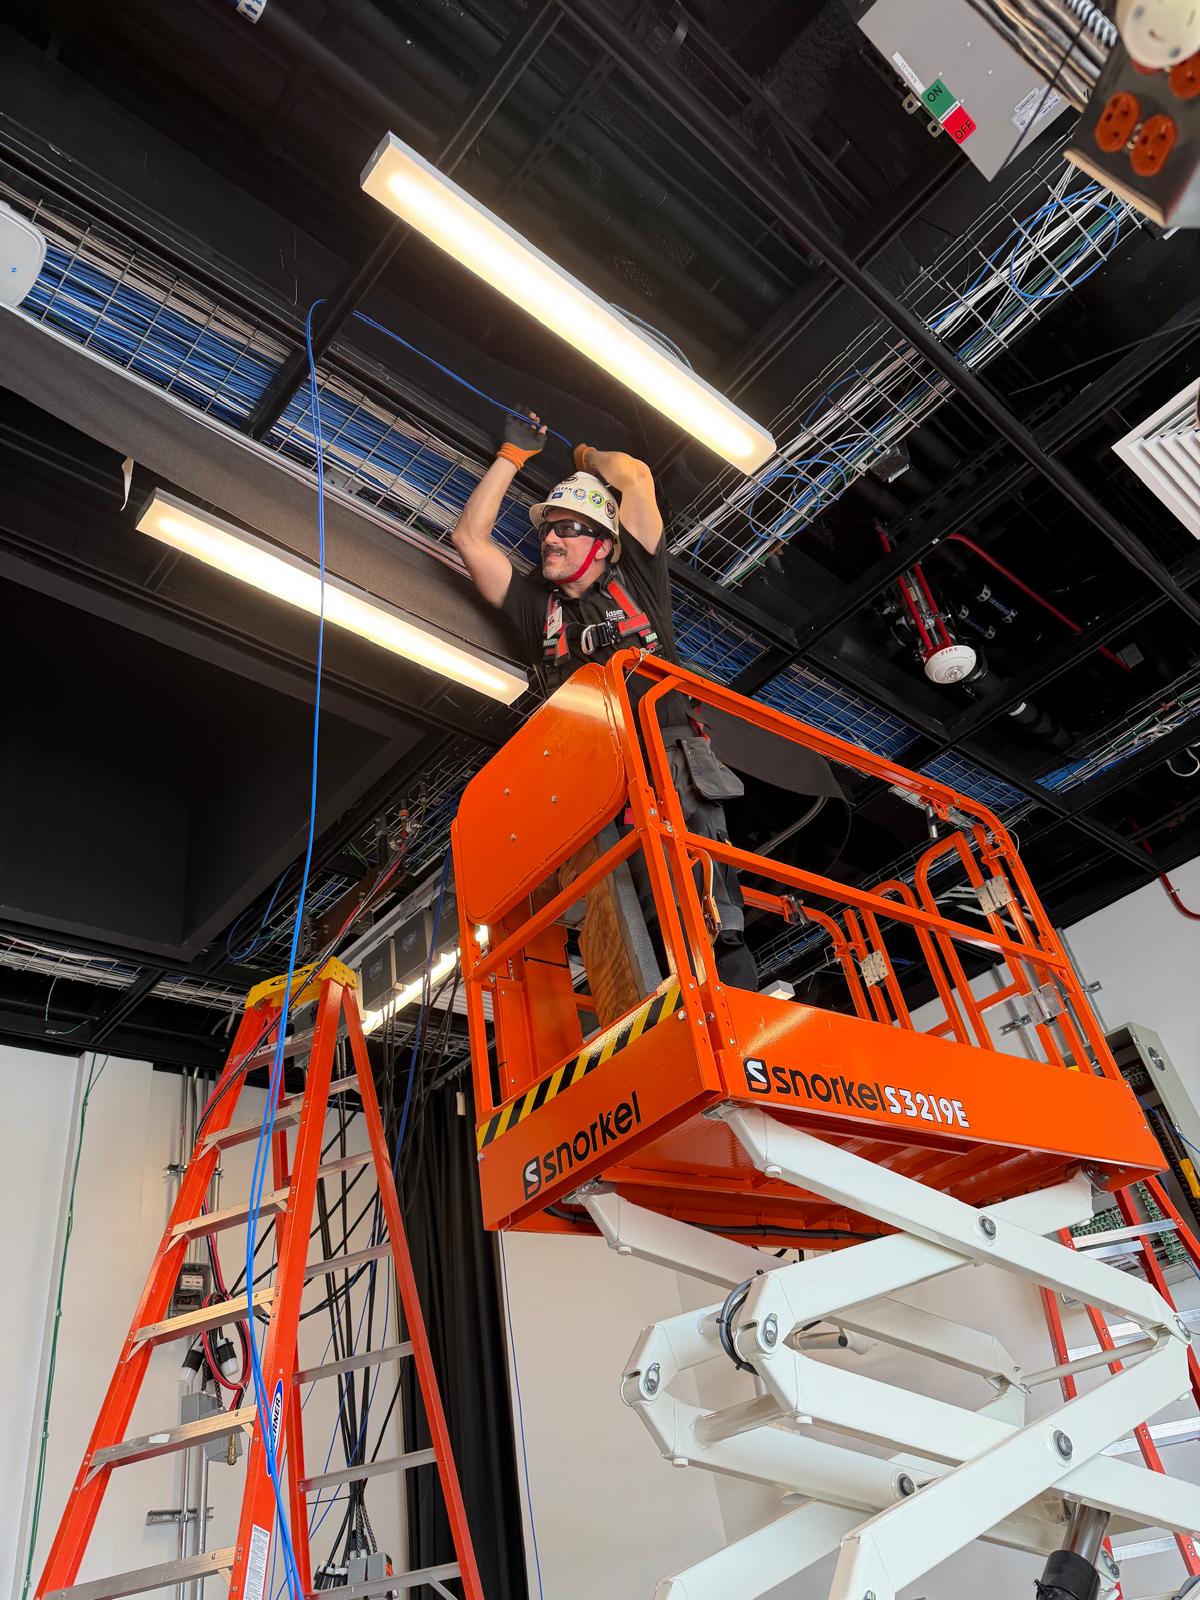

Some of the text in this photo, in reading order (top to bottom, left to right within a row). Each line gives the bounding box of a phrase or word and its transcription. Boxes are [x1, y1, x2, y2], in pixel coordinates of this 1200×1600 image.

[927, 85, 943, 102] ON
[954, 120, 974, 140] OFF
[941, 647, 958, 656] FIRE
[771, 1065, 887, 1113] snorkel
[884, 1085, 970, 1128] S3219E
[543, 1090, 641, 1184] snorkel
